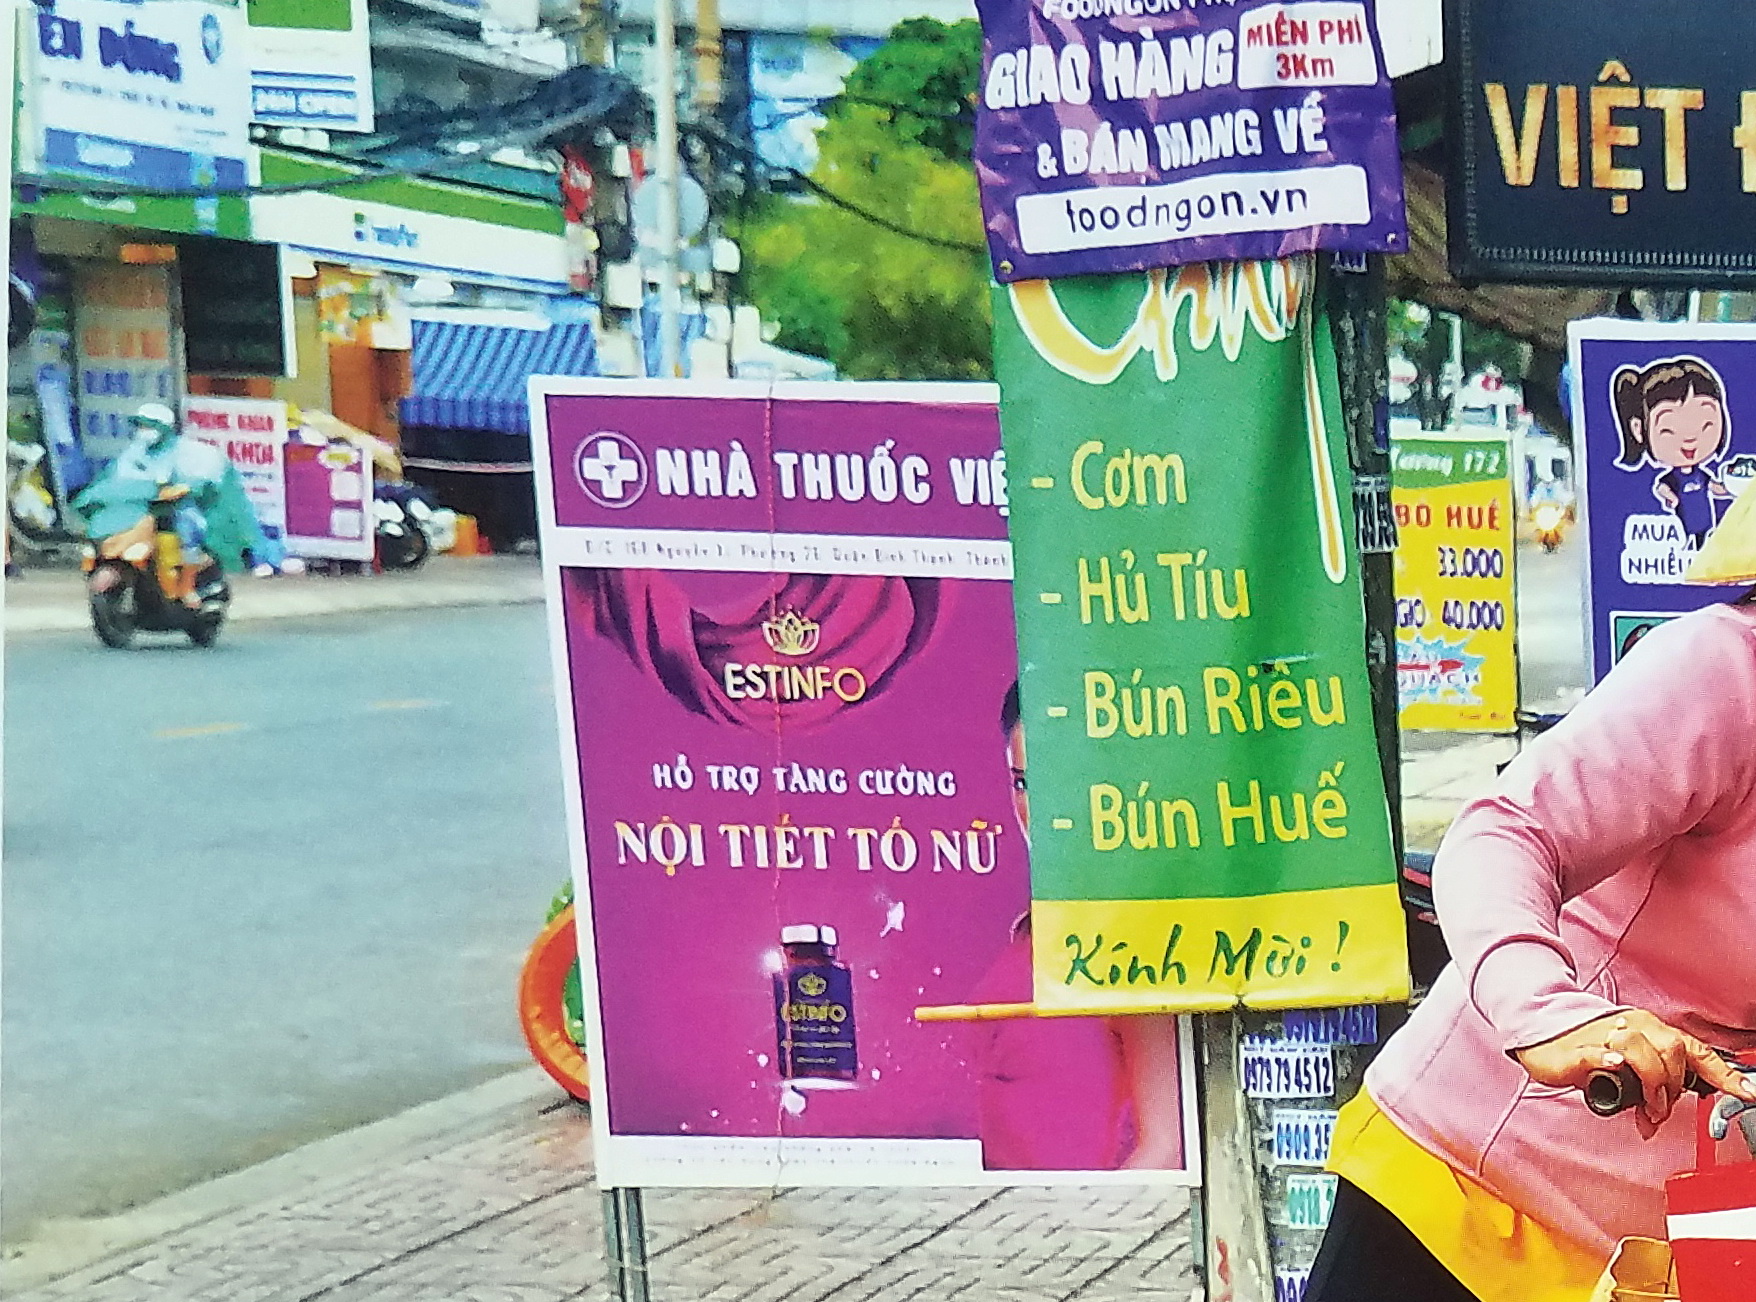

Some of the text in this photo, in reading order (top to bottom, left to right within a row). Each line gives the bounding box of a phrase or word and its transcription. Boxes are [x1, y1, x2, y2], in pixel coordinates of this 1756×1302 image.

[985, 27, 1236, 110] GIAO HÀNG
[1276, 52, 1335, 80] 3Km
[1036, 143, 1059, 179] &
[1061, 121, 1149, 176] BÁN
[1154, 108, 1262, 172] MANG
[1484, 60, 1705, 214] VIỆT
[1065, 187, 1309, 233] foodngon.vn
[655, 440, 758, 499] NHÀ
[773, 439, 931, 505] THUỐC
[1071, 440, 1188, 511] Cơm
[1631, 523, 1680, 542] MUA
[1078, 548, 1251, 625] Hủ Tíu
[724, 663, 867, 703] ESTINFO
[1084, 660, 1346, 739] Bún Riêu
[705, 762, 761, 796] TRỢ
[858, 762, 956, 797] CƯỜNG
[1090, 761, 1349, 851] Bún Huế
[613, 813, 1003, 877] NỘI TIẾT TỐ NỮ
[1065, 923, 1187, 987] Kính
[1208, 926, 1312, 983] Mời
